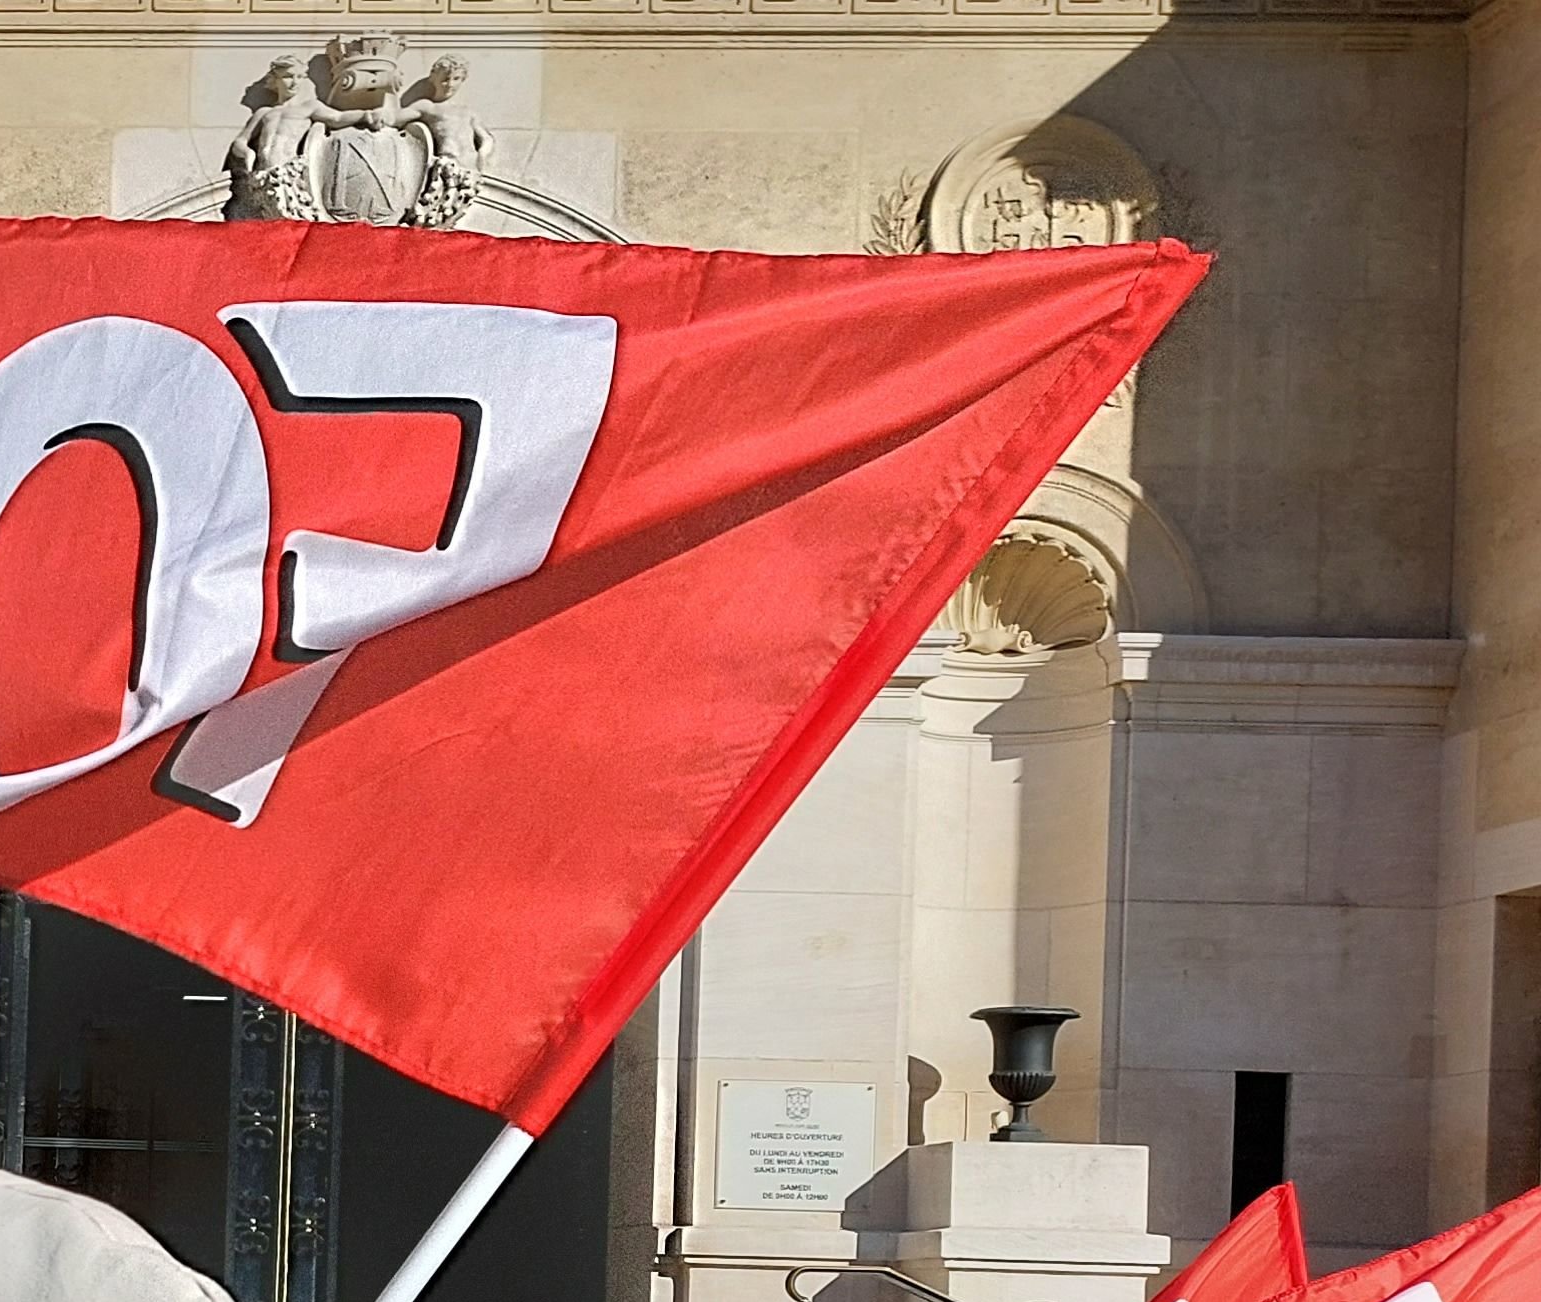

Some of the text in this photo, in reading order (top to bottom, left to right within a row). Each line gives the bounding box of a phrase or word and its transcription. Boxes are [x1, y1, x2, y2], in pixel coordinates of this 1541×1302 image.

[750, 1132, 784, 1140] HEURES
[763, 1149, 787, 1157] LUNDI
[778, 1167, 838, 1175] INTERRUPTION
